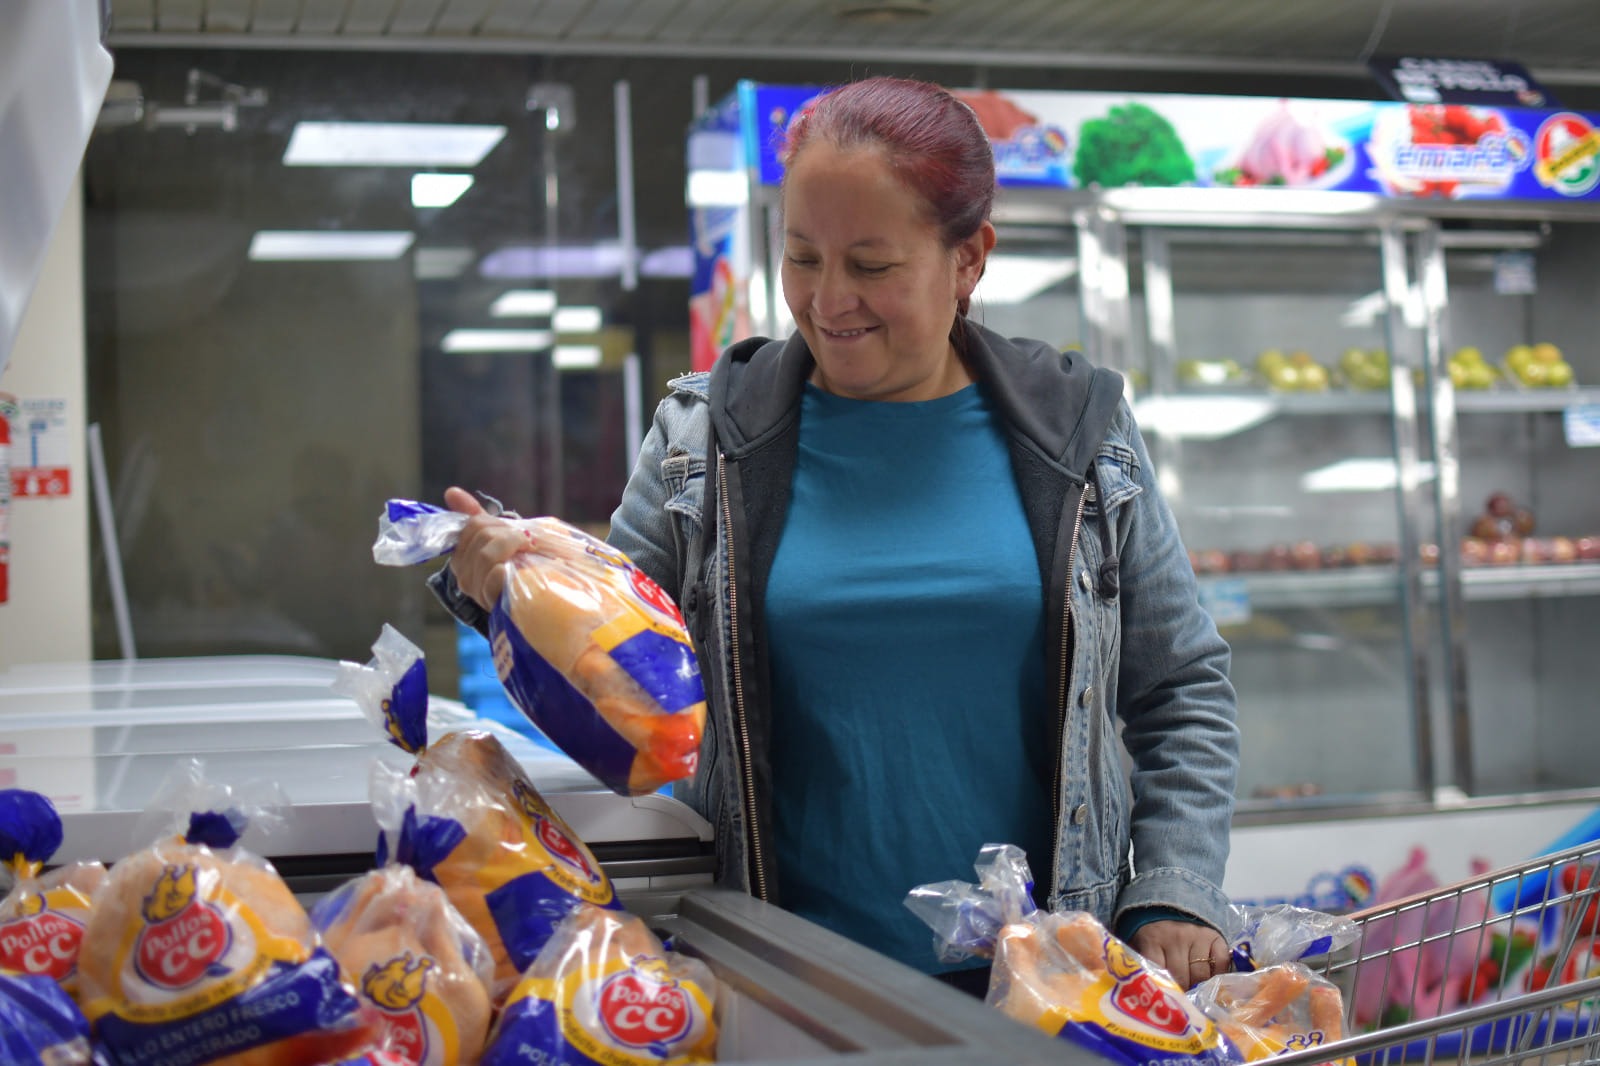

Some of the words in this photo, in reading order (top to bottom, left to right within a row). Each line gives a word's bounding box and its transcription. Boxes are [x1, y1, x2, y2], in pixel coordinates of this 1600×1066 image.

[1, 919, 69, 958] Pollos
[22, 930, 78, 974] CC
[145, 909, 213, 961] Pollos
[161, 927, 218, 977] CC
[609, 984, 683, 1011] Pollos
[158, 1011, 228, 1049] ENTERO
[230, 990, 300, 1024] FRESCO
[613, 1004, 676, 1033] CC
[1104, 1022, 1166, 1047] Producto
